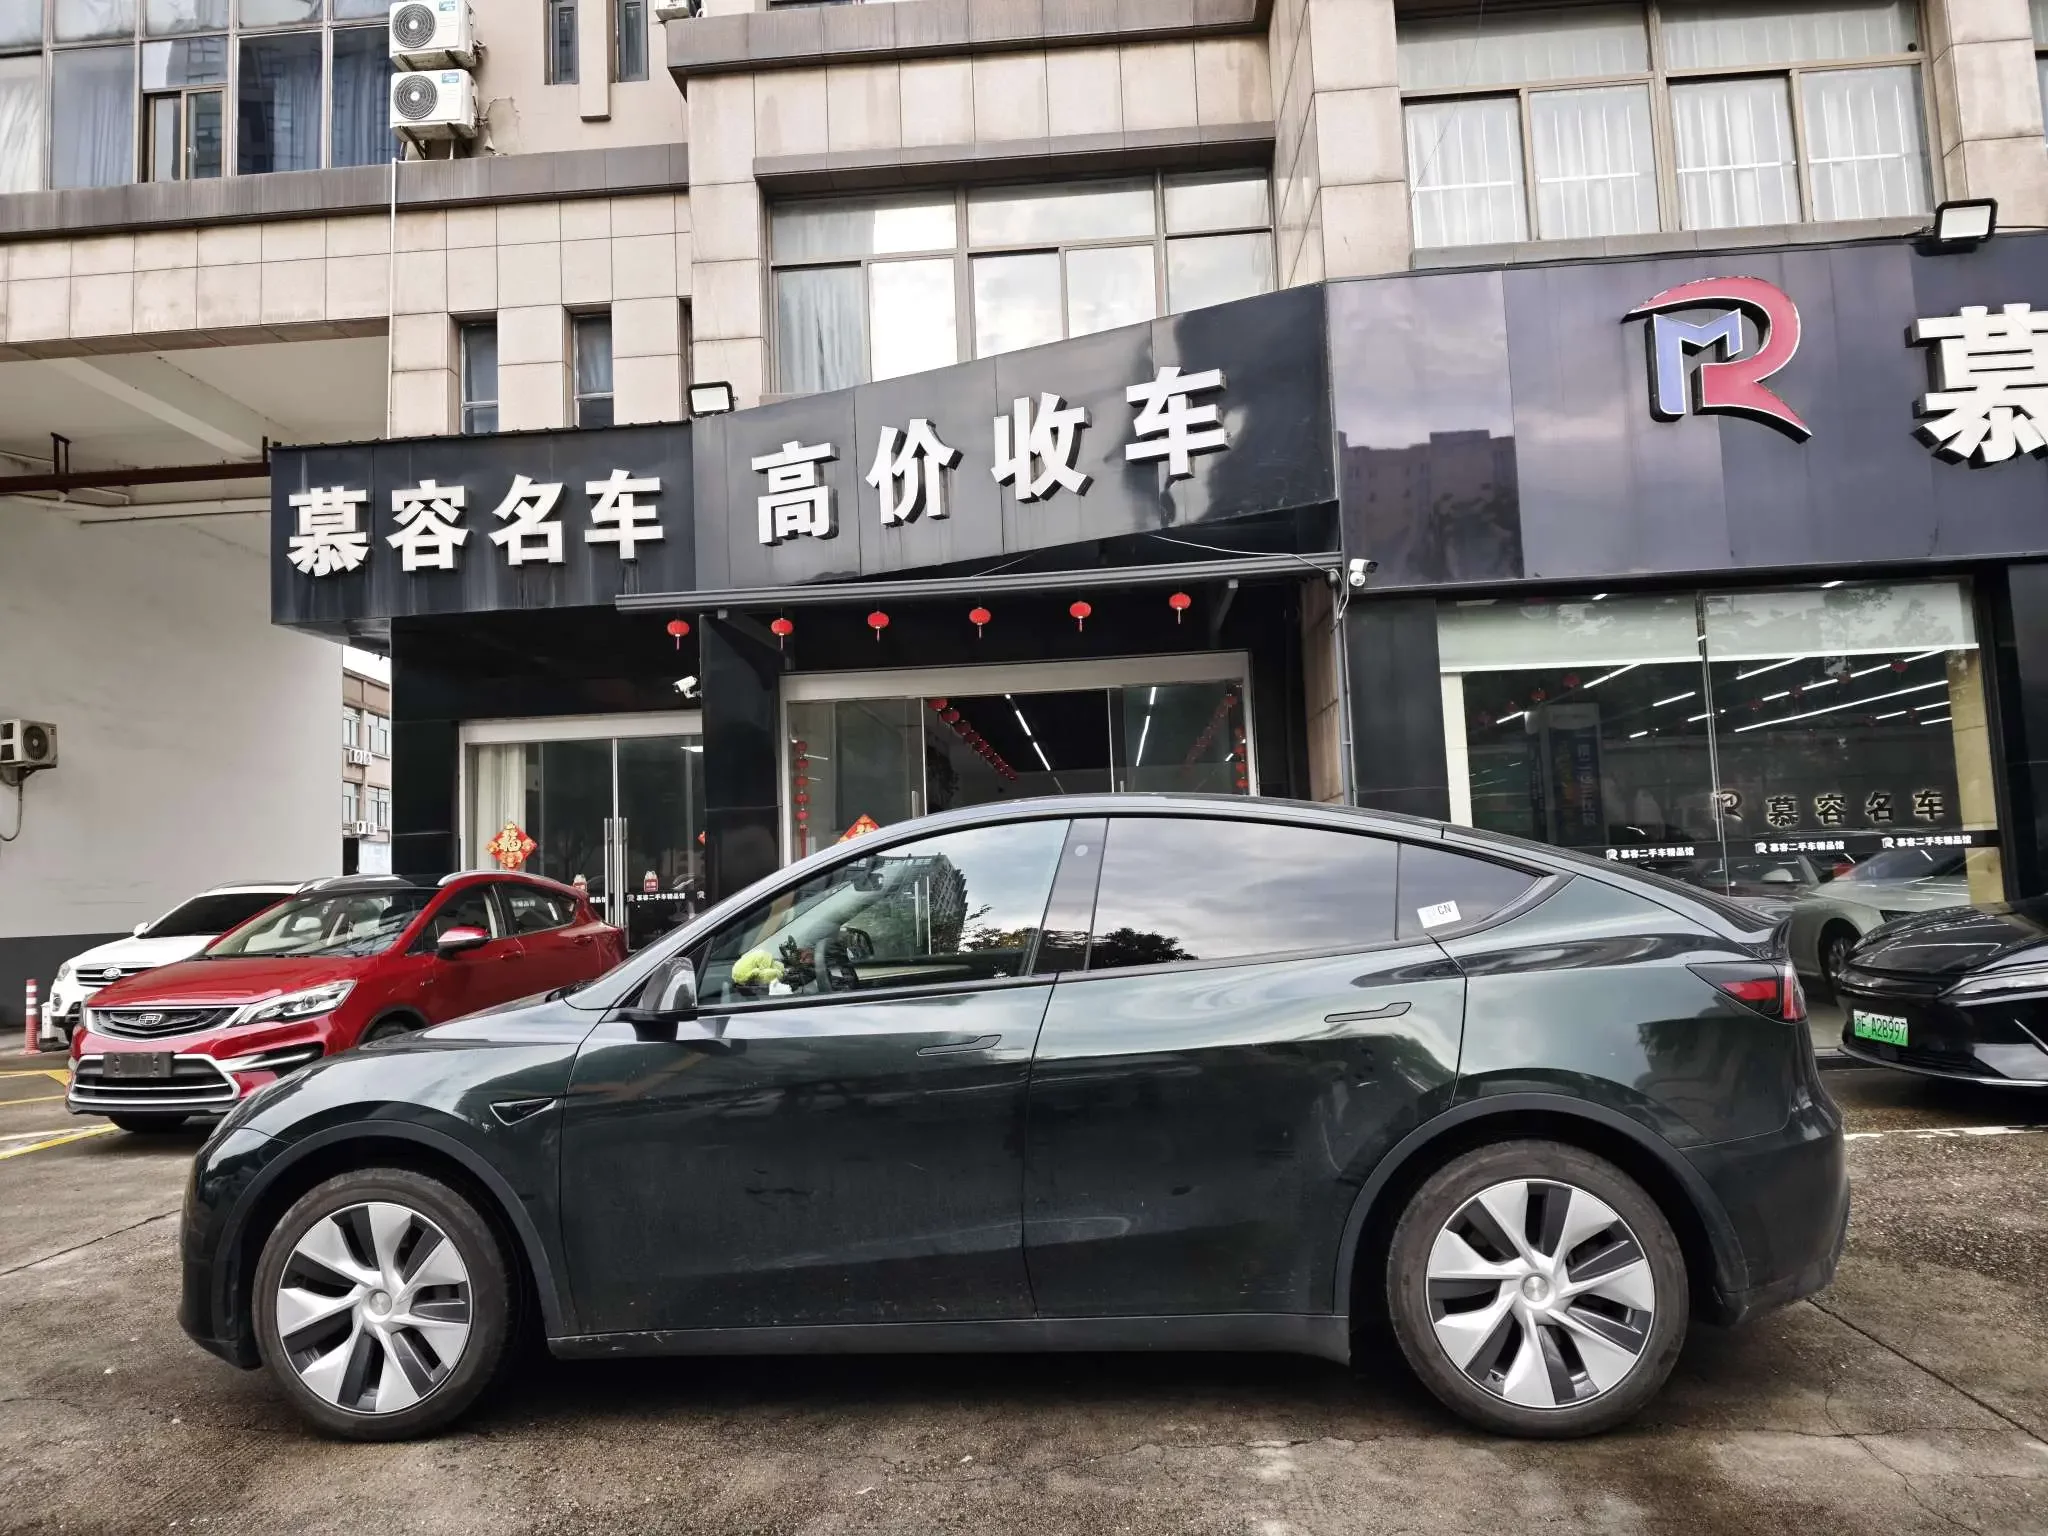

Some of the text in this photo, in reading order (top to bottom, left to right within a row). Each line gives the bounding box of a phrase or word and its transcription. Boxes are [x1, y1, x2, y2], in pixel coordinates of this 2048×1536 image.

[751, 366, 1232, 545] 高价收车
[286, 469, 665, 577] 慕容名车
[1766, 790, 1945, 827] 慕容名车
[1437, 903, 1452, 915] CN
